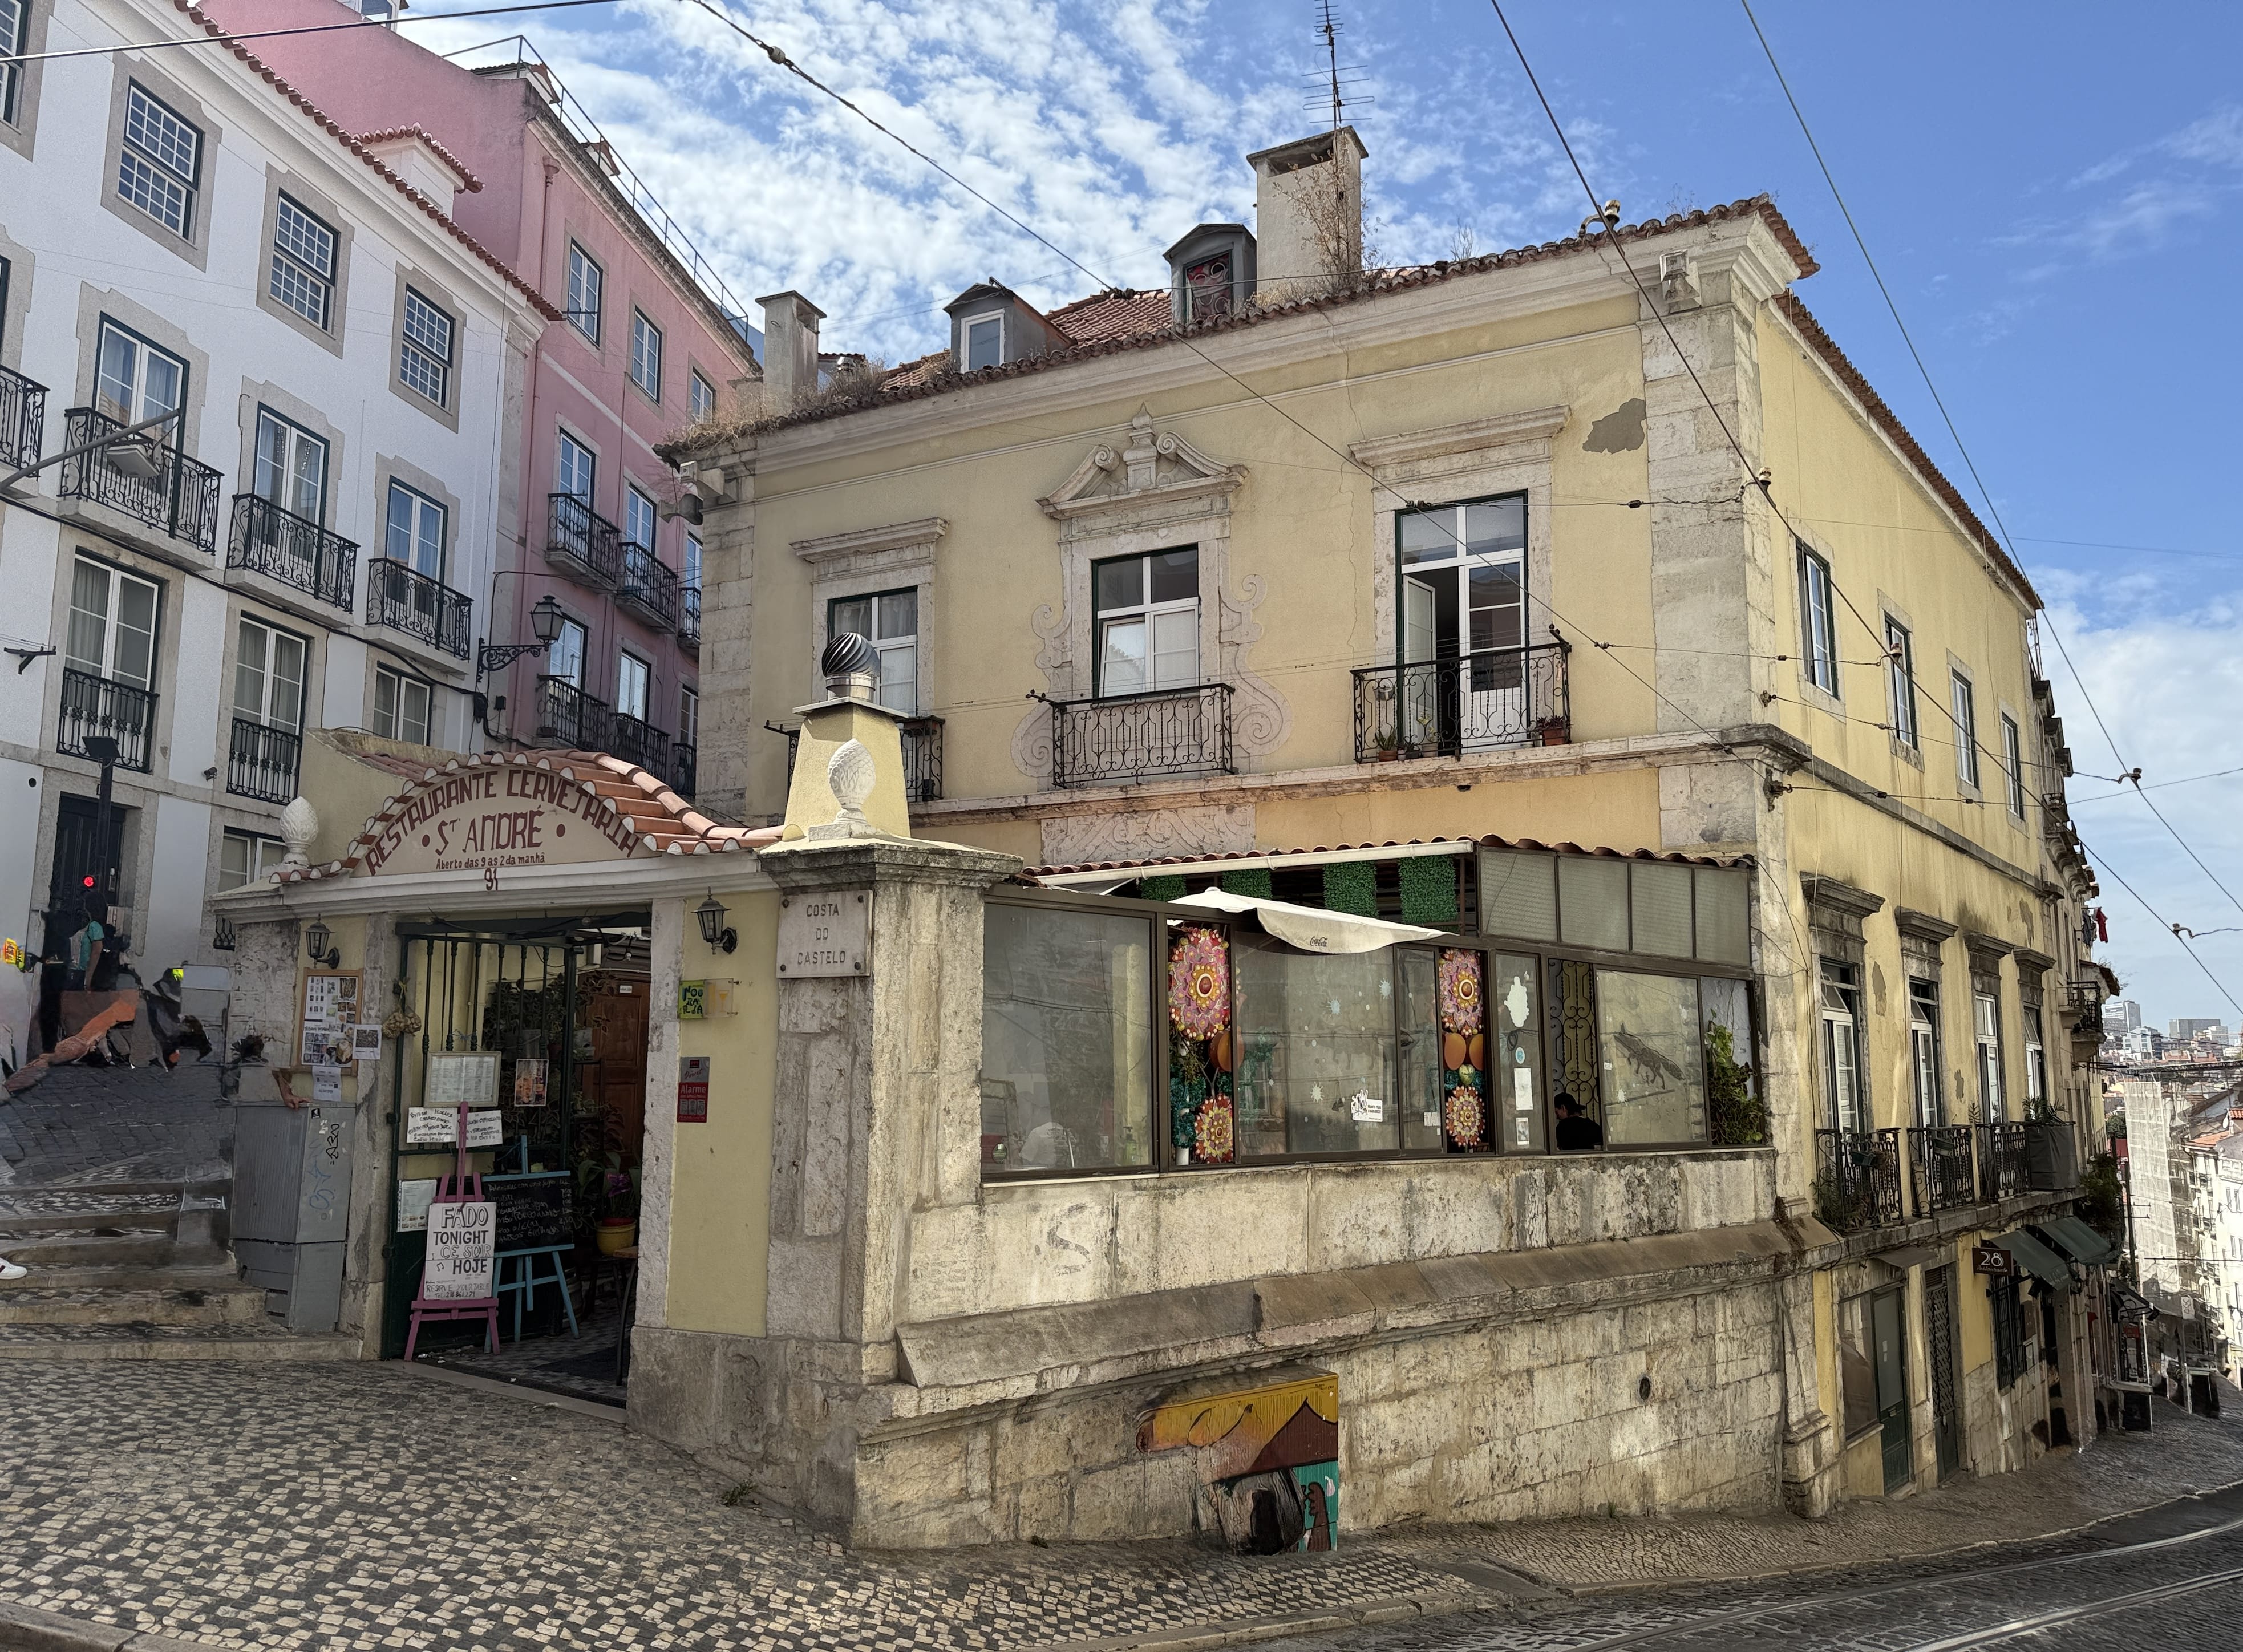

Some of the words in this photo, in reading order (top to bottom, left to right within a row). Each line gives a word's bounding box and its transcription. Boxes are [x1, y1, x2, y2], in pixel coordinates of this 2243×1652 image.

[365, 771, 498, 876] RESTAURANTE
[507, 770, 639, 857] CERVEJARIA
[462, 805, 545, 853] ANDRÉ
[436, 858, 462, 869] Aberto
[464, 857, 479, 868] das
[481, 857, 485, 867] 9
[488, 857, 497, 866] as
[500, 856, 504, 866] 2
[505, 855, 515, 865] da
[484, 868, 499, 890] 91
[807, 904, 839, 917] COSTA
[816, 928, 828, 940] DO
[797, 951, 845, 965] CASTELO
[681, 1084, 706, 1094] Alarme
[441, 1206, 489, 1228] FADO
[433, 1230, 488, 1245] TONIGHT
[440, 1245, 459, 1259] CE
[463, 1244, 491, 1258] SOIR
[1980, 1251, 2004, 1266] 28
[452, 1258, 488, 1274] HOJE
